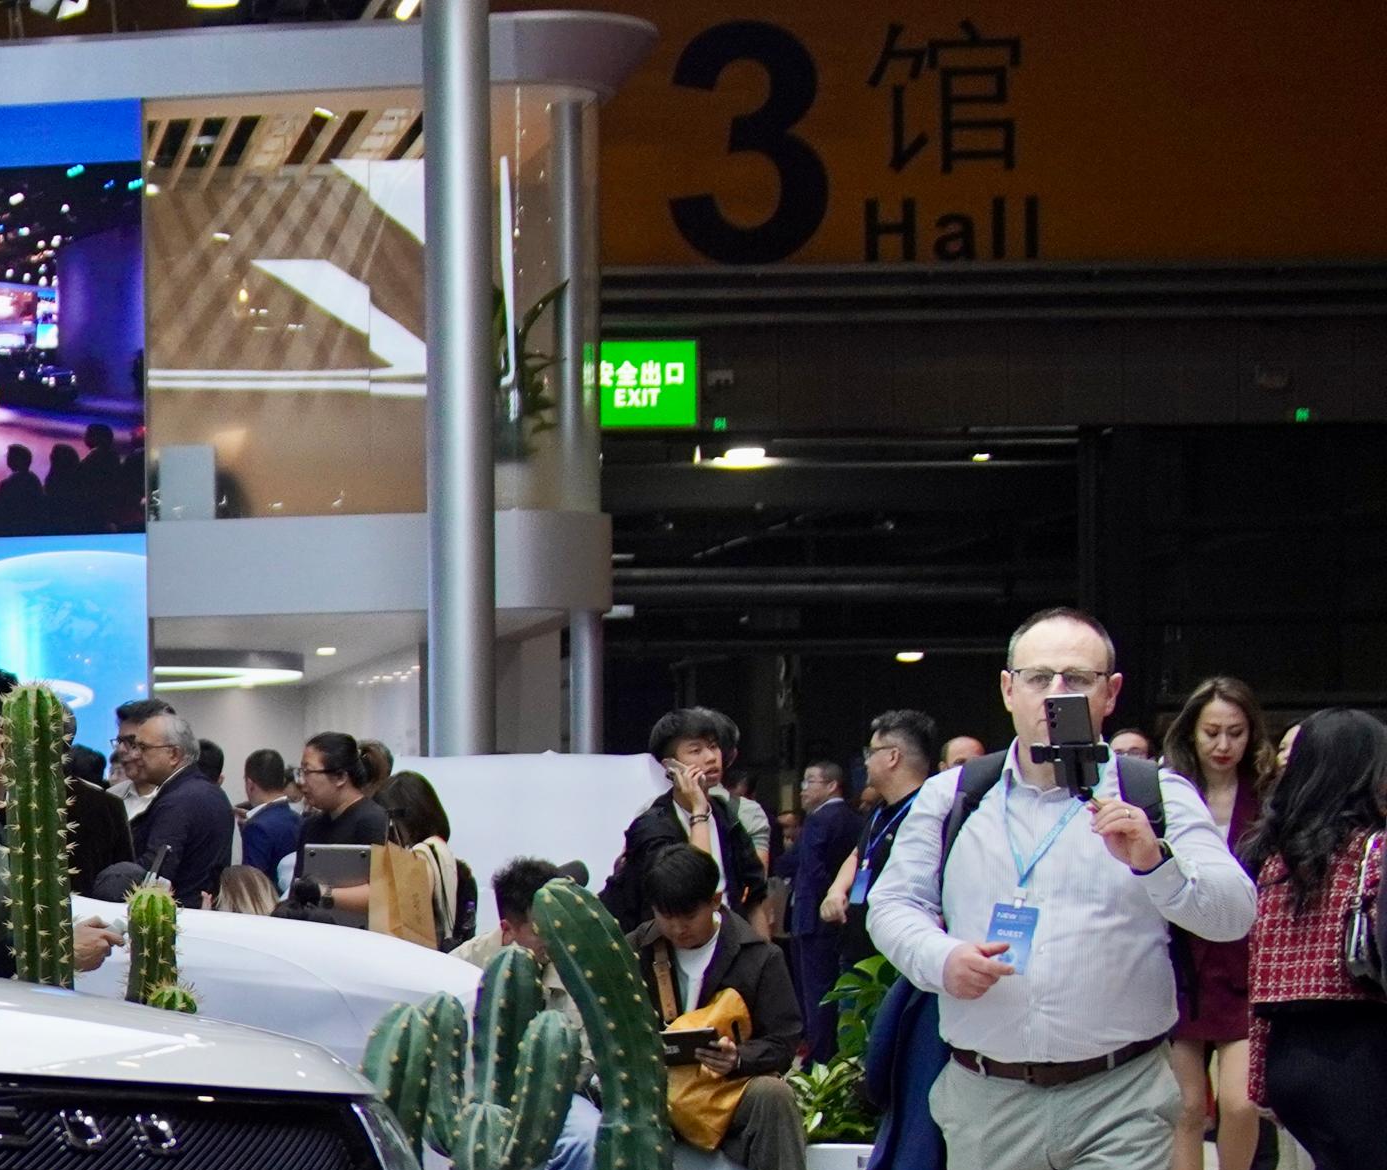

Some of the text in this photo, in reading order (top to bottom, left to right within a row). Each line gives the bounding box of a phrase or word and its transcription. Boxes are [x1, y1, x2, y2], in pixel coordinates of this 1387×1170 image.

[670, 18, 1022, 265] 3 馆
[864, 195, 1040, 263] Hall
[613, 387, 661, 408] EXIT
[997, 928, 1024, 938] GUEST
